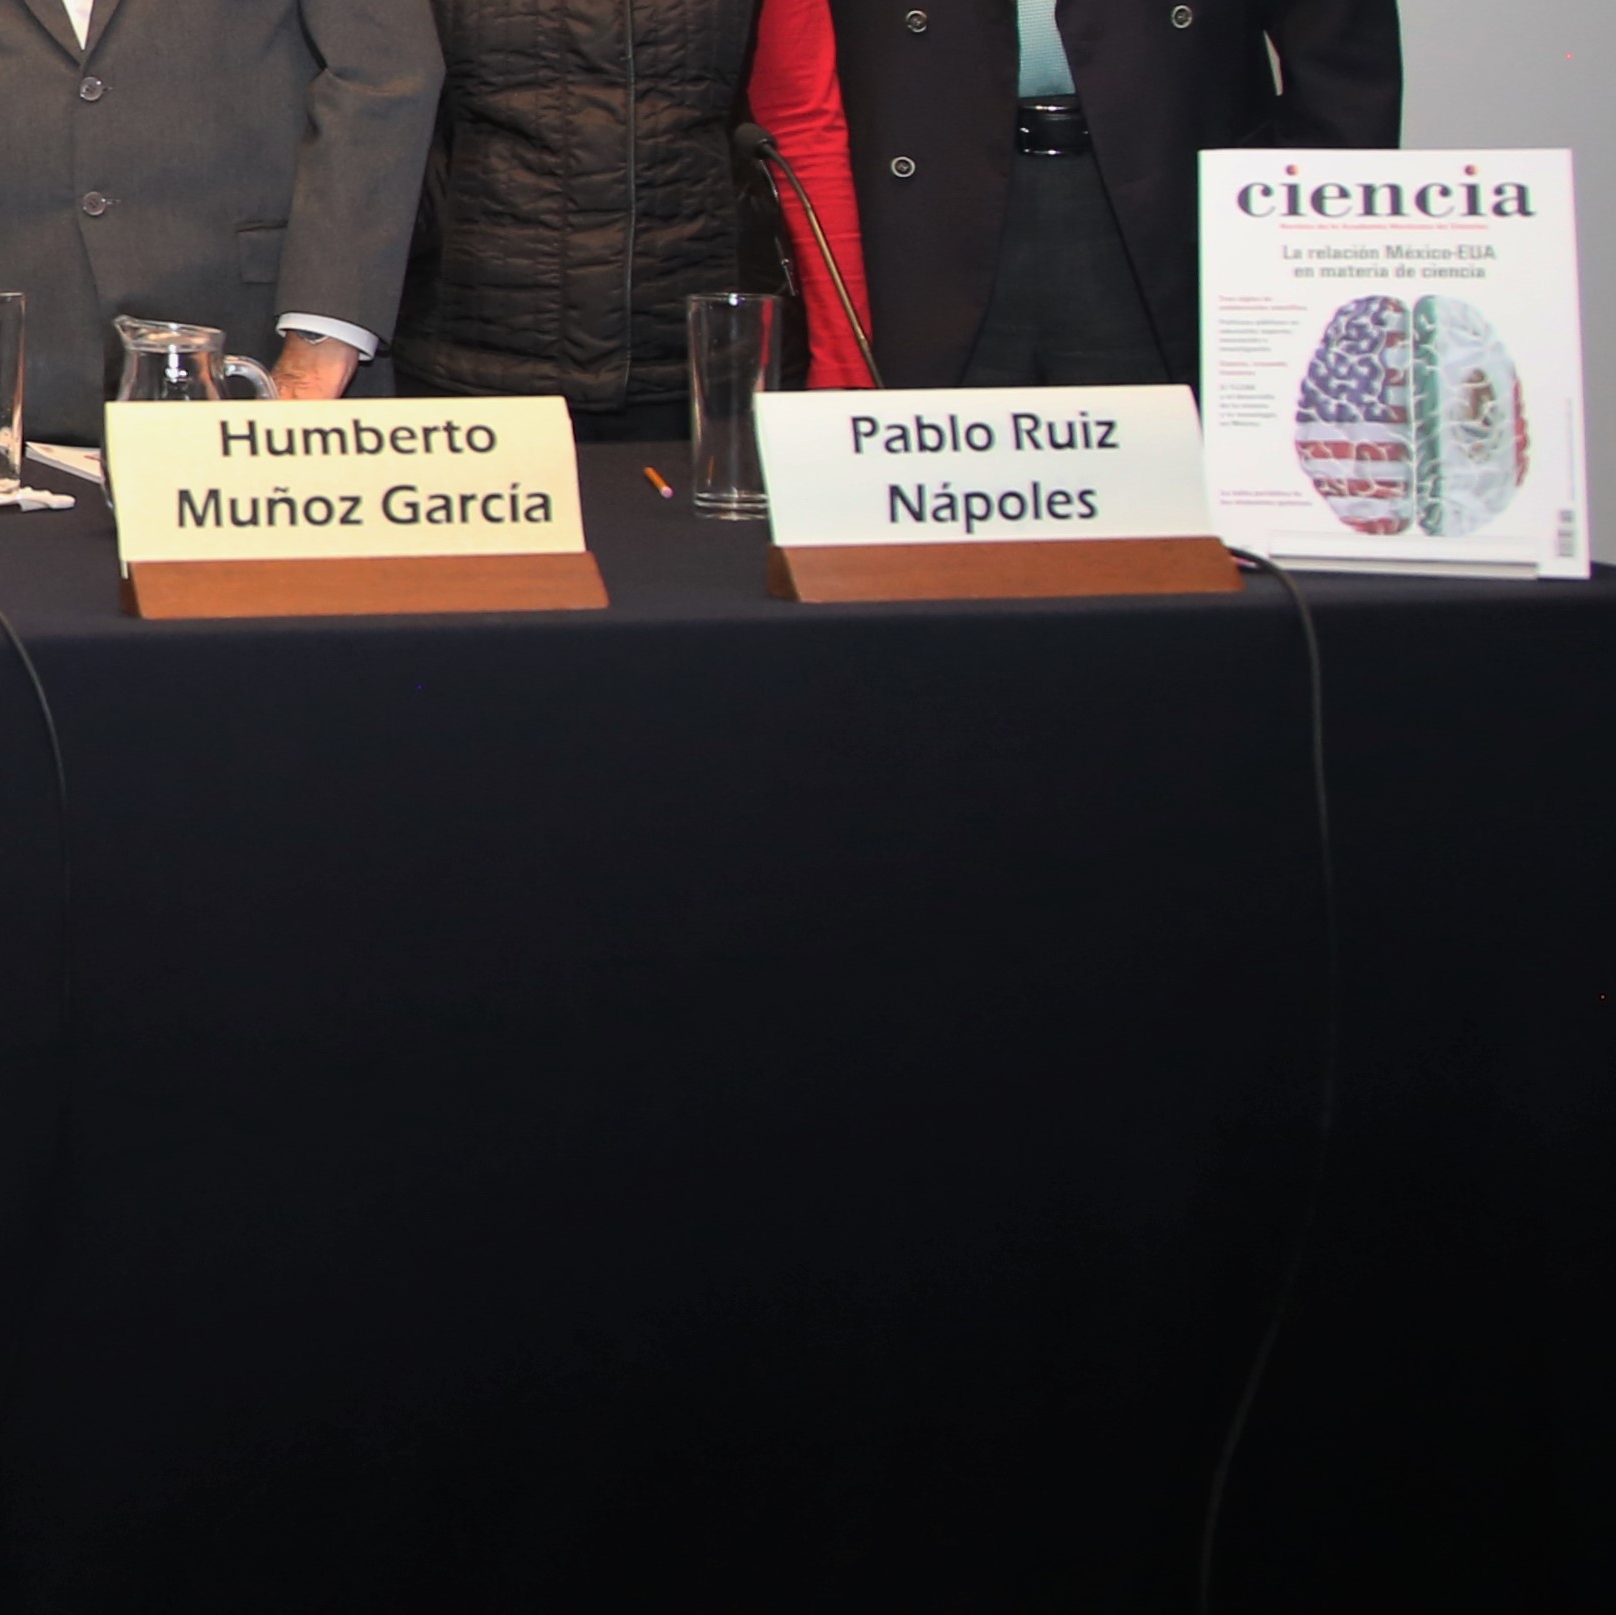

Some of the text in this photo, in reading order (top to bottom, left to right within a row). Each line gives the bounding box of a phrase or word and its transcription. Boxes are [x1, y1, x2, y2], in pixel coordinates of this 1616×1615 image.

[1237, 164, 1537, 218] ciencia
[1282, 244, 1302, 260] La
[1308, 244, 1379, 260] relación
[1293, 263, 1486, 278] en materia de ciencia
[219, 419, 498, 457] Humberto
[850, 411, 1120, 455] Pablo Ruiz
[177, 481, 553, 528] Muñoz García
[889, 481, 1099, 534] Nápoles
